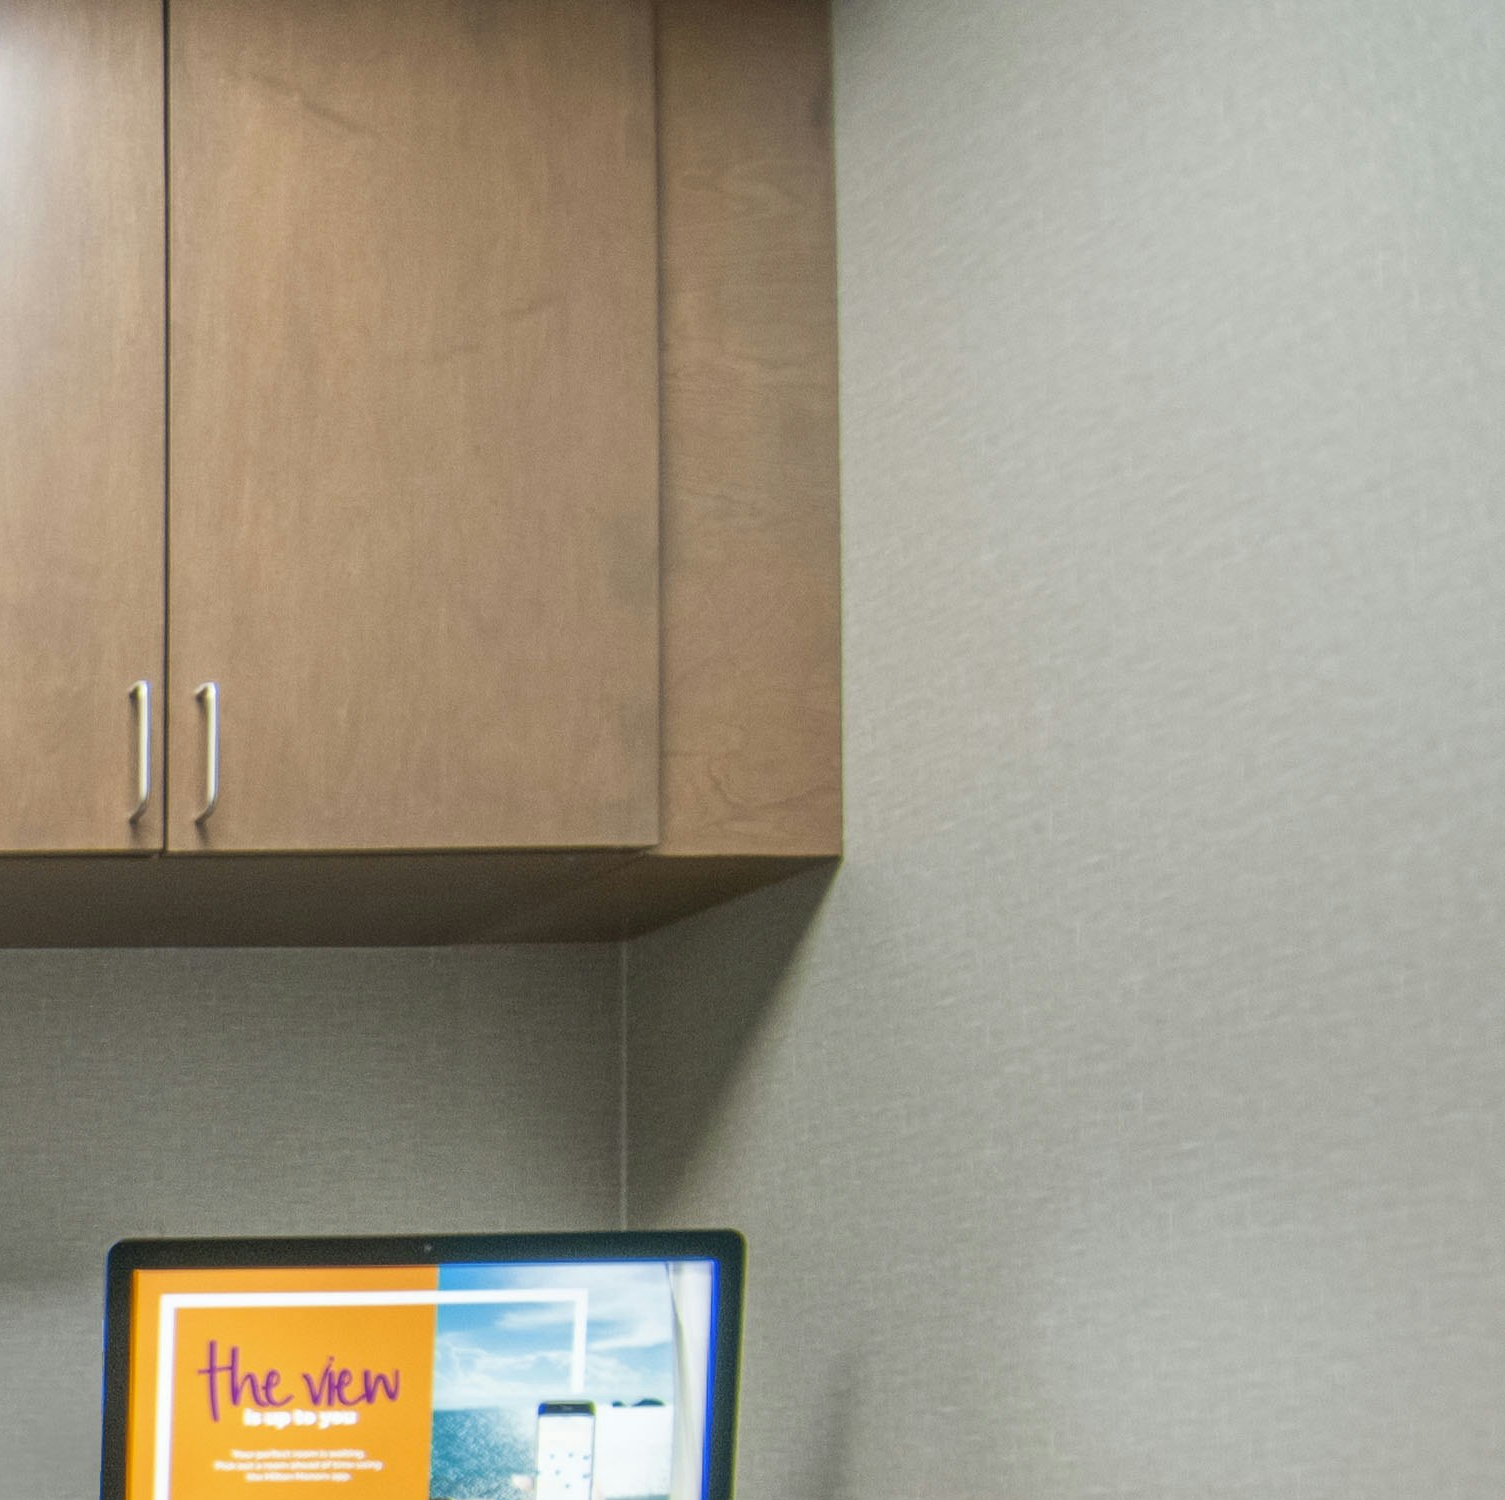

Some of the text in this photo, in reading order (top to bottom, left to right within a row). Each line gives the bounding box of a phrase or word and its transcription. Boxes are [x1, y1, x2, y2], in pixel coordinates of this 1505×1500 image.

[197, 1339, 401, 1424] the view
[242, 1407, 360, 1429] is up to you
